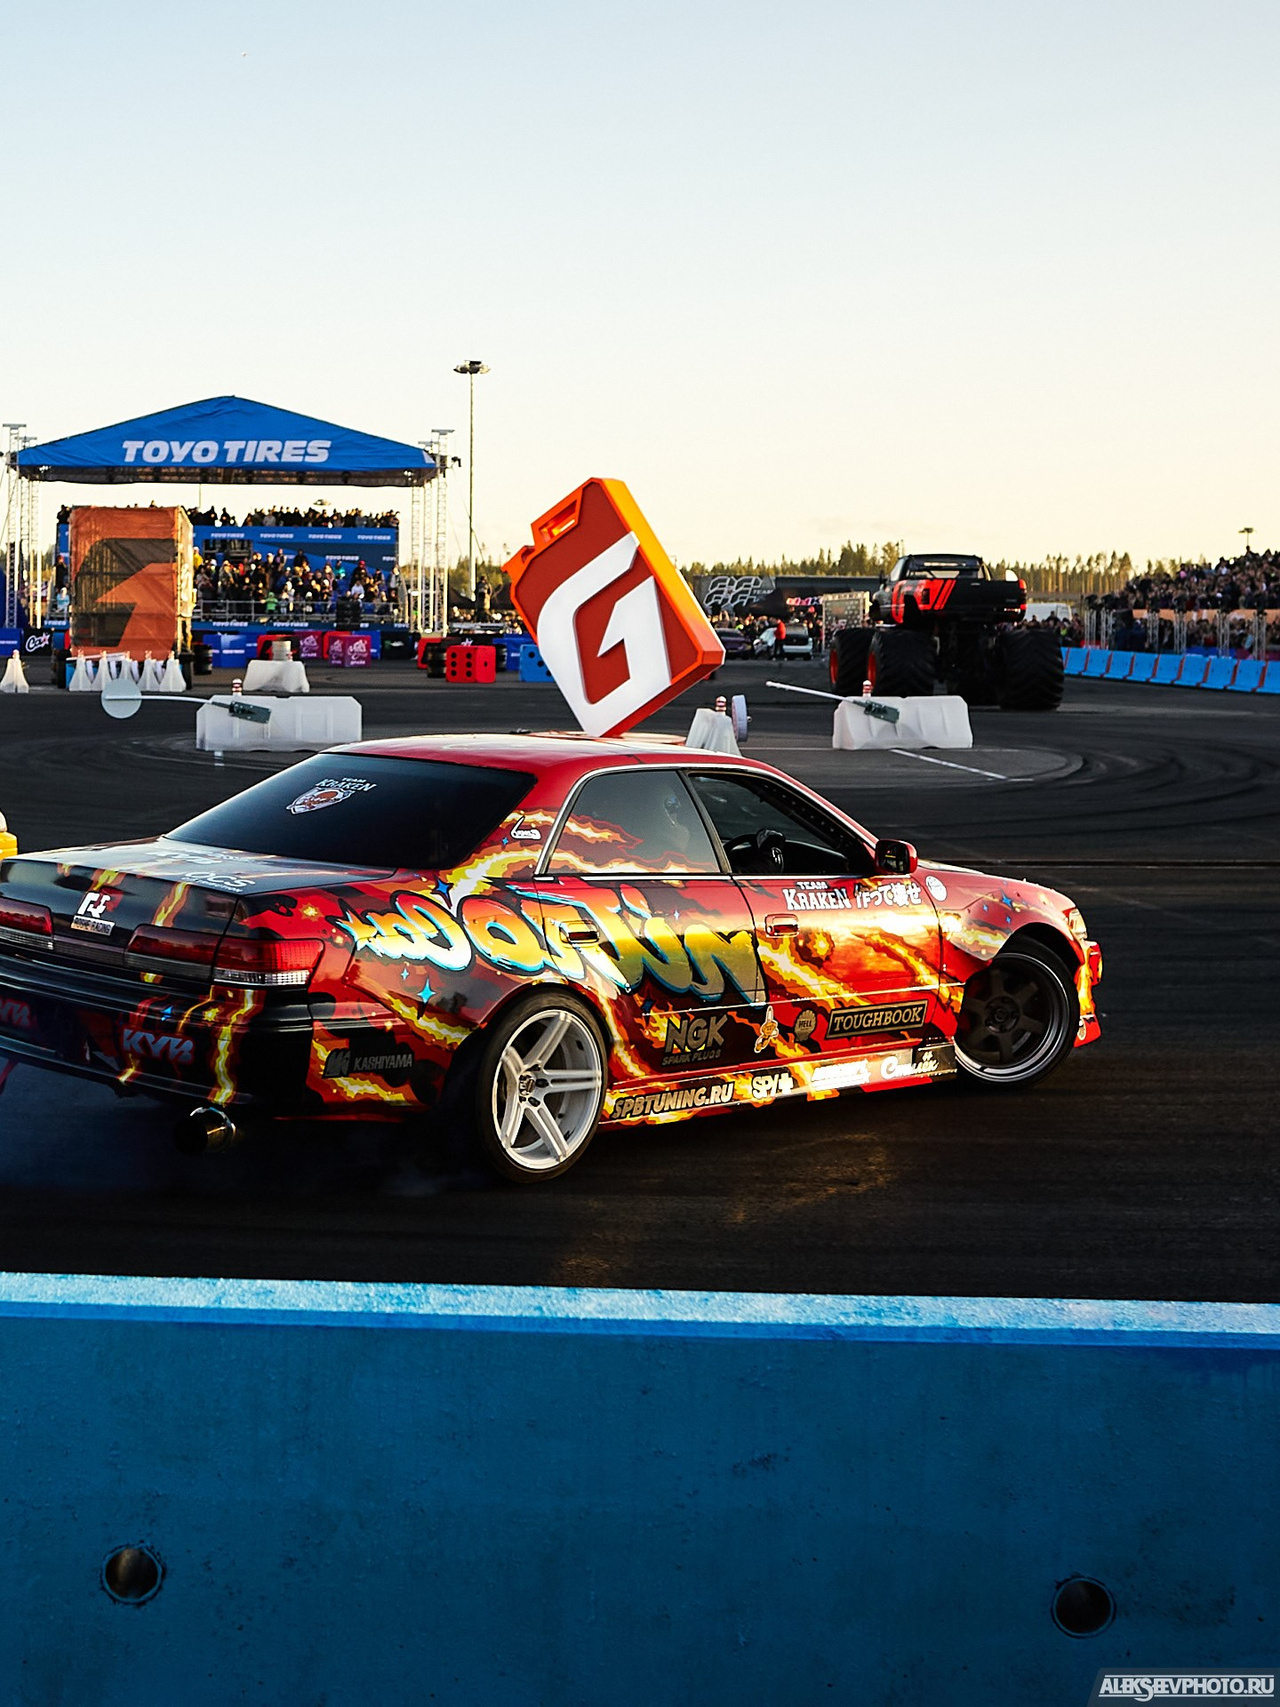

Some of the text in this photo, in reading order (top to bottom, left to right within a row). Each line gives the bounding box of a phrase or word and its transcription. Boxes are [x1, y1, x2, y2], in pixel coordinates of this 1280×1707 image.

[123, 440, 332, 463] TOYO TIRES
[315, 779, 377, 792] KRAKEN
[796, 881, 829, 890] TEAM
[782, 888, 852, 911] KRAKEN
[834, 1006, 923, 1032] TOUGHBOOK
[665, 1014, 728, 1053] NGK
[123, 1028, 194, 1063] KYB
[353, 1053, 413, 1071] KASHIYAMA
[661, 1053, 692, 1066] SPARK
[611, 1082, 734, 1119] SPBTUNING.RU
